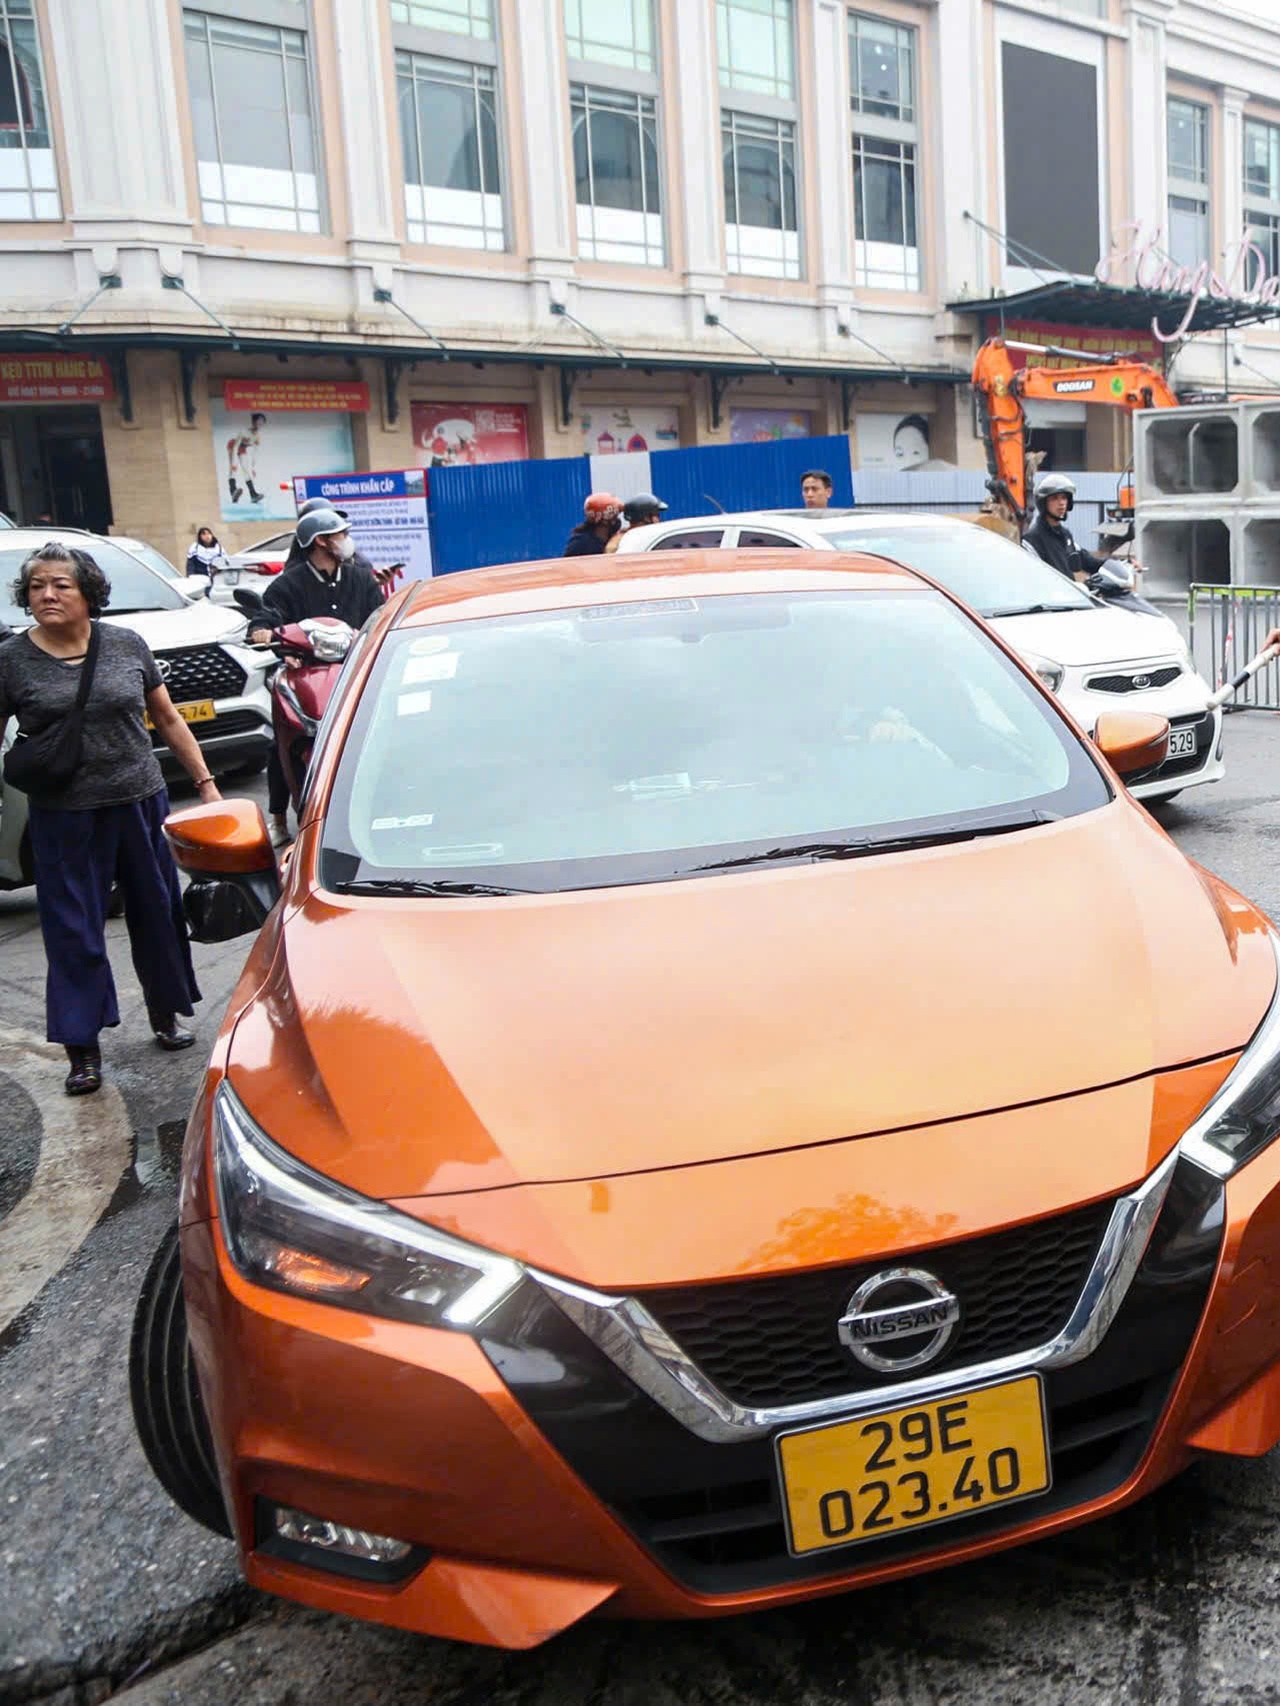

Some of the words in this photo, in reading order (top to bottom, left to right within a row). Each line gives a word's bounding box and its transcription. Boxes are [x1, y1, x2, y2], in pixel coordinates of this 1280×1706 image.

[849, 1301, 949, 1338] NISSAN
[860, 1401, 972, 1473] 29E
[818, 1447, 1020, 1538] 023.40
